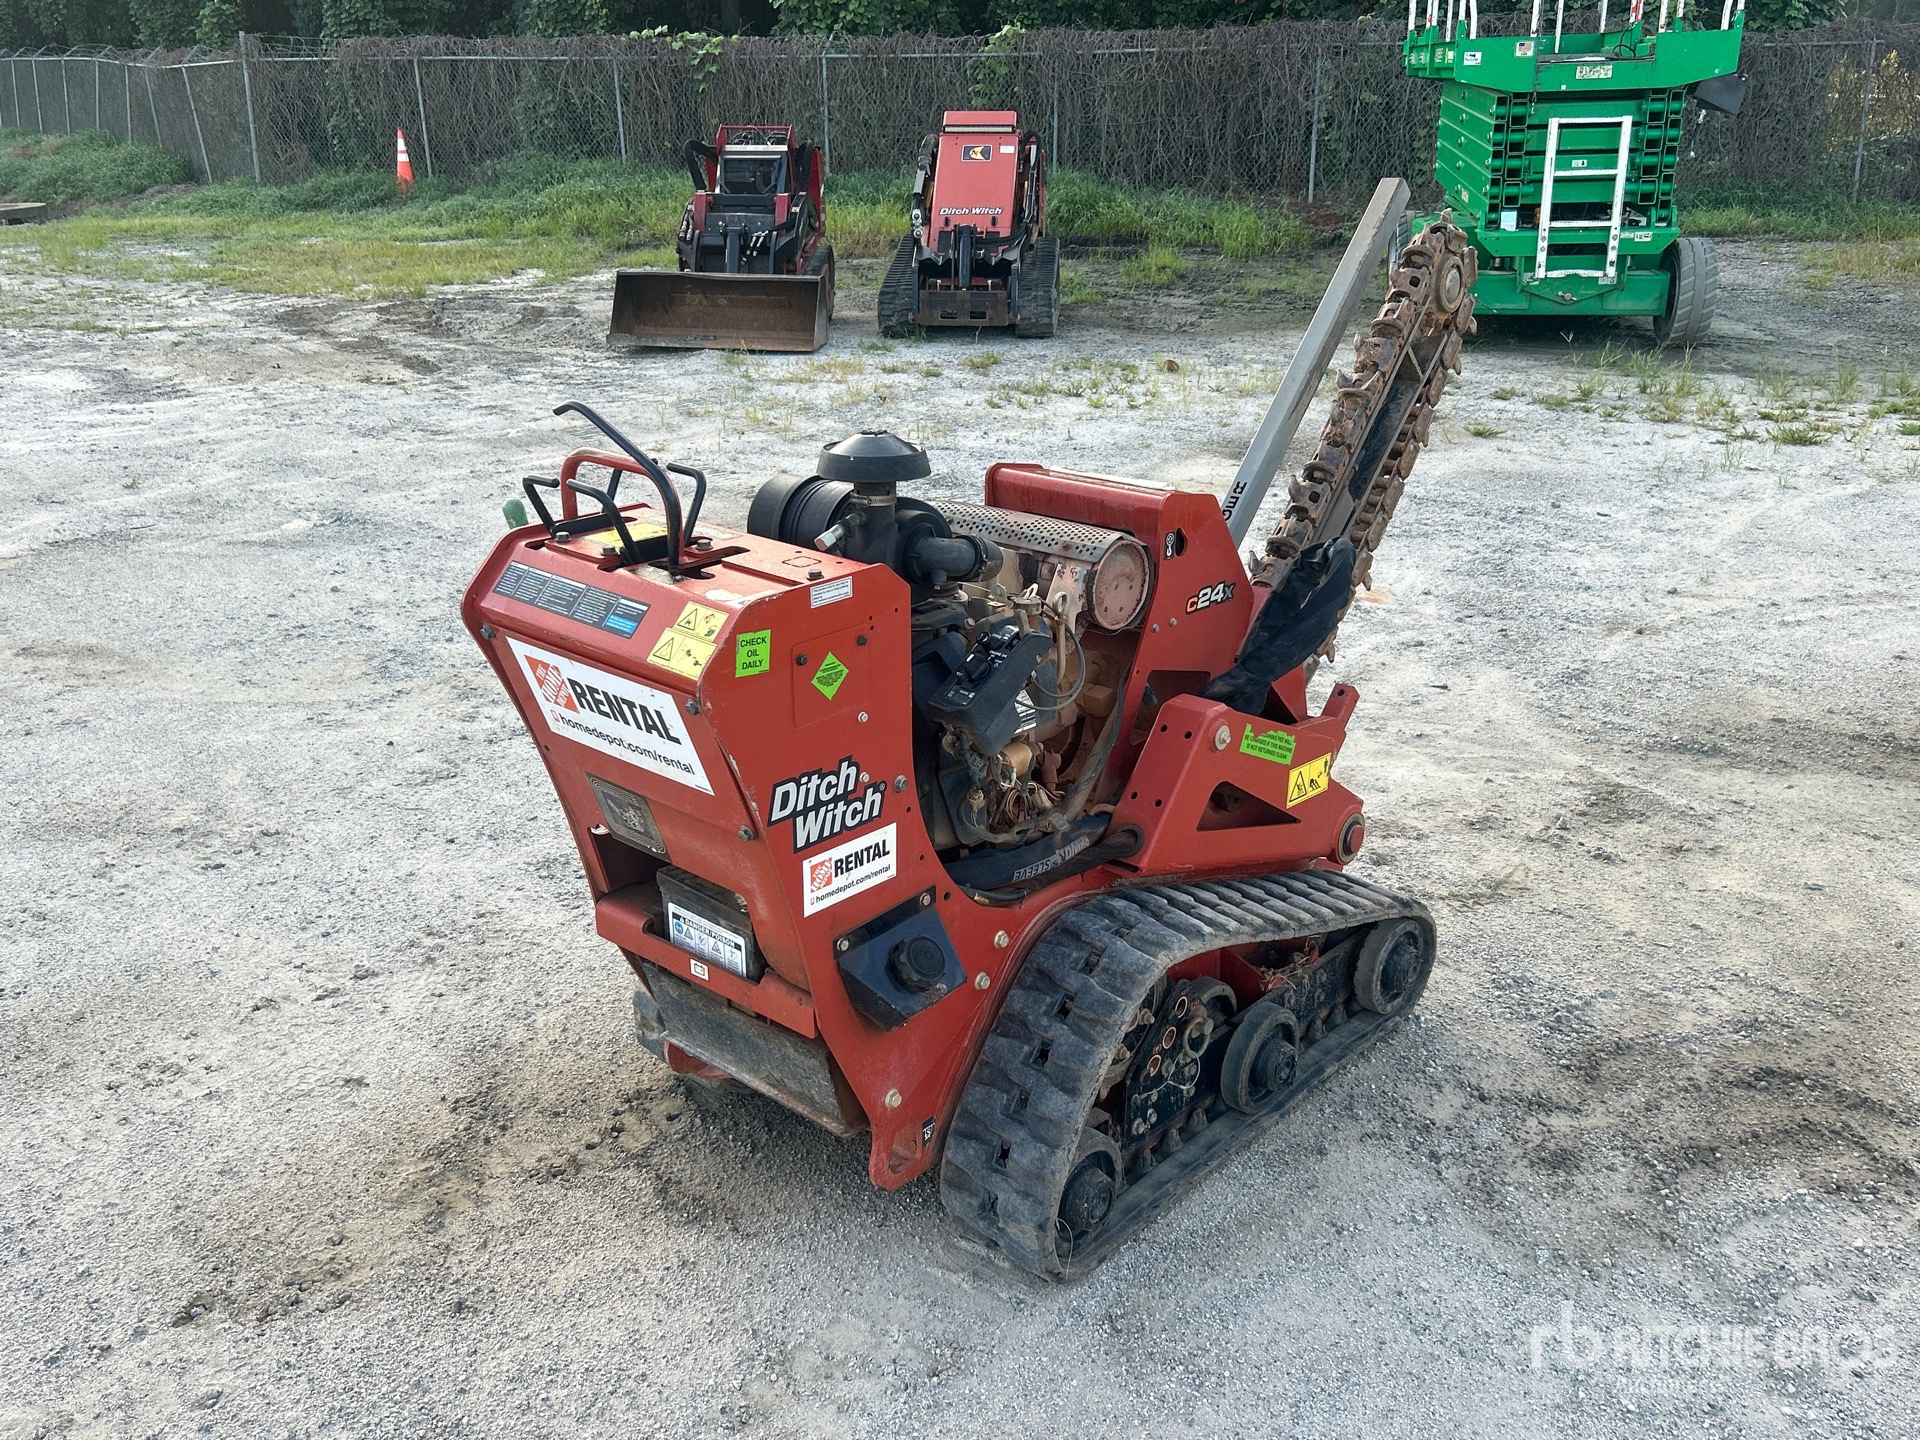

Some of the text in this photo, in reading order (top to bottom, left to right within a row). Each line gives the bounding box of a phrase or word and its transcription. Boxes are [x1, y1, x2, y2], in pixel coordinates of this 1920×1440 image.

[939, 207, 1003, 215] Ditch Witch
[740, 636, 767, 648] CHECK
[746, 649, 759, 658] OIL
[742, 659, 763, 670] DAILY
[566, 677, 682, 745] RENTAL
[560, 712, 695, 775] homedepot.com/rental
[770, 760, 857, 822] Ditch
[834, 839, 890, 878] RENTAL
[1013, 859, 1050, 880] SLEEVE
[815, 864, 890, 903] homedepot.com/rental
[686, 918, 736, 947] DANGER/POISON
